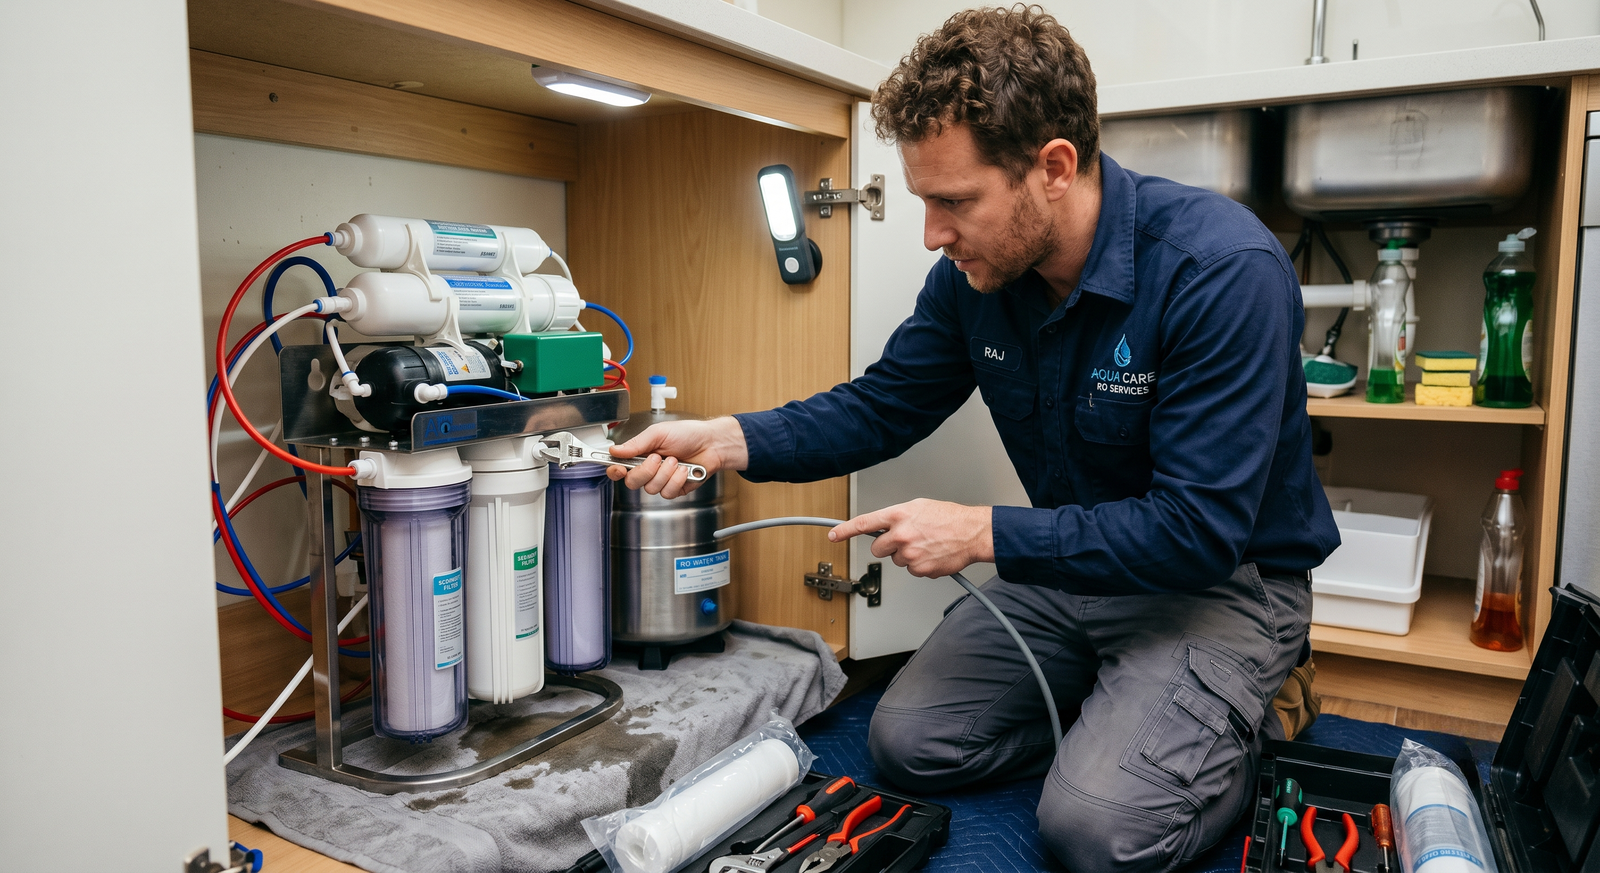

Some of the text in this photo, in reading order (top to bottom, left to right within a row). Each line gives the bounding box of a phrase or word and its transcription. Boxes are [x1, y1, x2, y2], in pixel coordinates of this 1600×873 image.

[984, 346, 1005, 361] RAJ
[1091, 368, 1157, 385] AQUA CARE
[1096, 382, 1150, 395] RO SERVICES
[680, 560, 691, 568] RO
